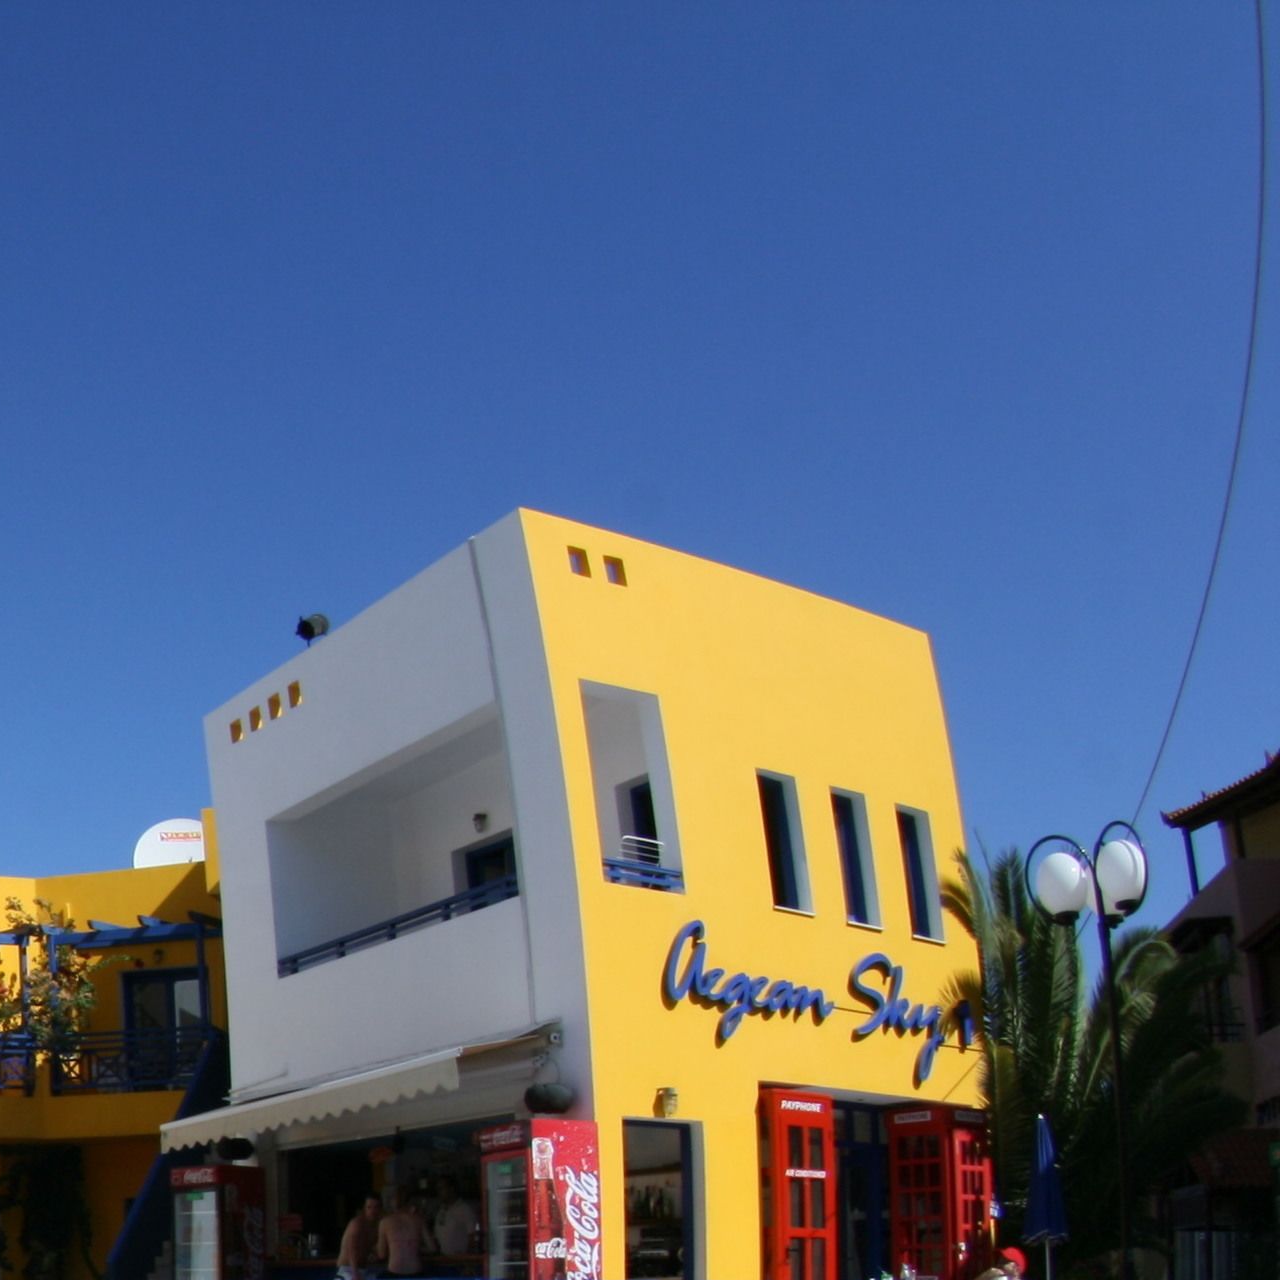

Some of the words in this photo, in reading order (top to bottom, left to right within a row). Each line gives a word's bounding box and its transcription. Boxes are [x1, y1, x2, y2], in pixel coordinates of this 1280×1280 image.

[662, 919, 834, 1041] Aegean
[850, 952, 944, 1083] Sky
[781, 1100, 822, 1113] PAYPHONE
